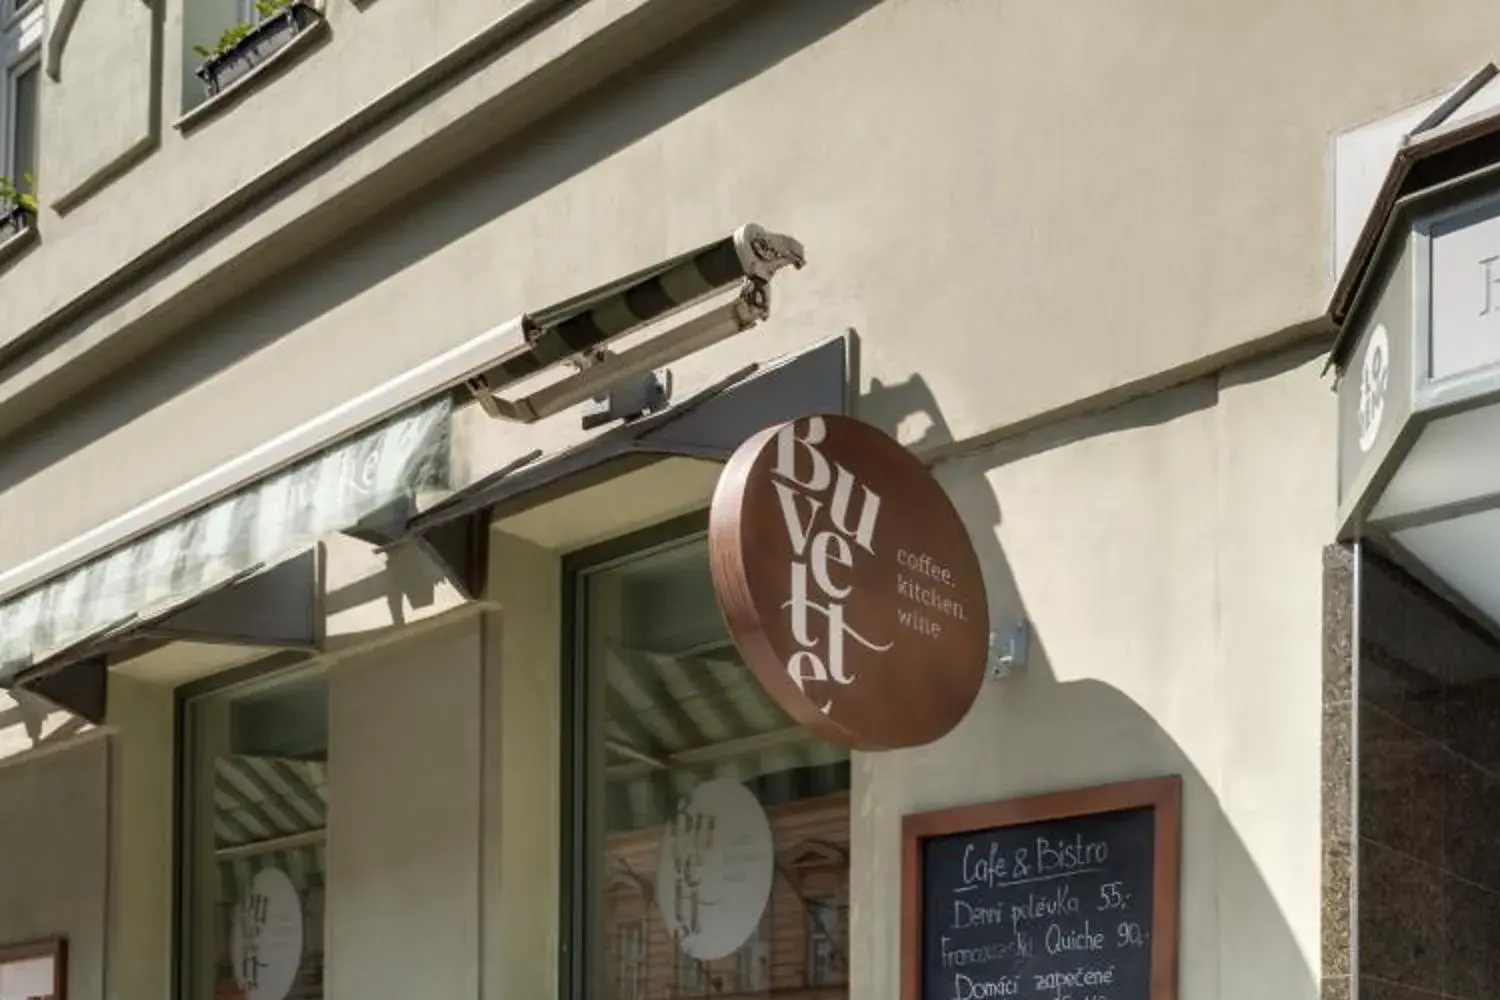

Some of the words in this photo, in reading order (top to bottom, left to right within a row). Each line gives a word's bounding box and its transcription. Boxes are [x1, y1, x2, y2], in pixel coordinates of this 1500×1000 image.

[897, 608, 941, 639] wine
[1012, 848, 1032, 877] &
[1037, 832, 1108, 874] Bistro
[1045, 919, 1105, 956] Quiche
